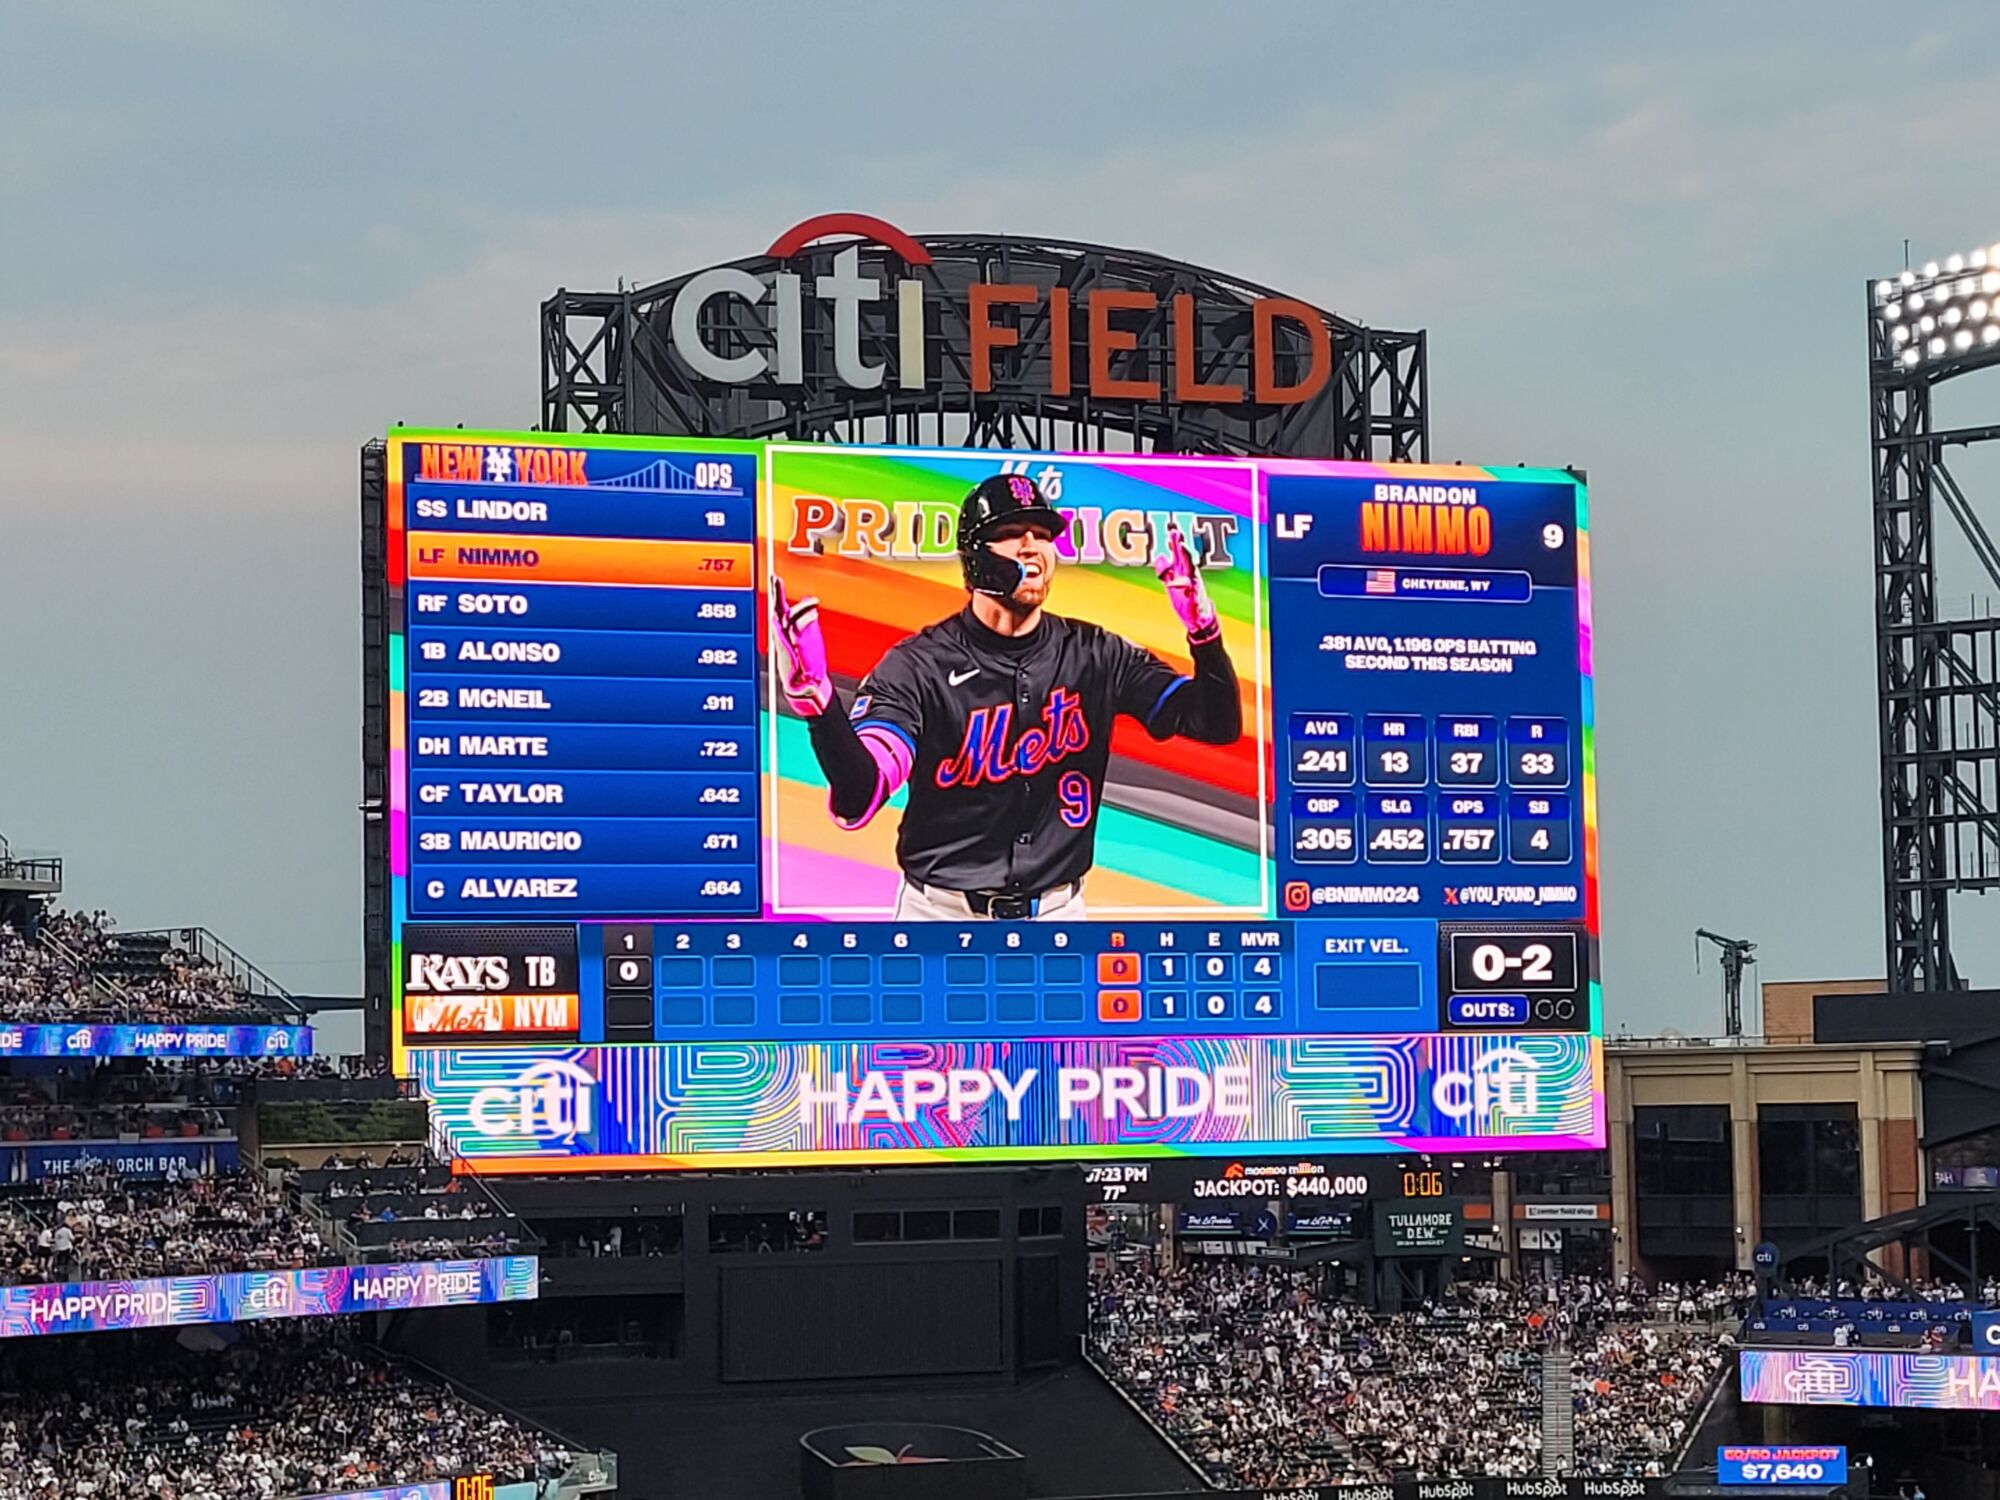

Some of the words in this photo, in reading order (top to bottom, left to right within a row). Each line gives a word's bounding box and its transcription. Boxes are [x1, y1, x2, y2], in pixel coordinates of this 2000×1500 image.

[672, 245, 924, 389] citi
[969, 284, 1331, 404] FIELD
[421, 445, 483, 482] NEW
[514, 448, 588, 486] YORK
[695, 463, 732, 489] OPS
[1374, 484, 1477, 505] BRANDON
[417, 499, 447, 517] SS
[457, 500, 547, 522] LINDOR
[705, 512, 725, 527] 1B
[788, 496, 962, 560] PRID
[1276, 513, 1313, 539] LF
[1361, 502, 1490, 556] NIMMO
[1543, 524, 1564, 549] 9
[418, 548, 445, 564] LF
[458, 548, 539, 567] NIMMO
[697, 558, 735, 572] .757
[1402, 578, 1469, 592] CHEYENNE,
[1470, 580, 1490, 591] WY
[418, 594, 448, 612] RF
[458, 594, 528, 614] SOTO
[697, 603, 737, 619] .858
[421, 642, 446, 660] 1B
[458, 641, 560, 662] ALONSO
[697, 650, 737, 665] .982
[1319, 636, 1350, 650] .381
[1354, 636, 1392, 654] AVG,
[1433, 639, 1466, 653] OPS
[1467, 639, 1537, 655] BATTING
[1345, 655, 1409, 670] SECOND
[1411, 656, 1448, 671] THIS
[1449, 656, 1513, 672] SEASON
[419, 690, 449, 708] 2B
[459, 689, 551, 709] MCNEIL
[702, 696, 734, 711] .911
[935, 685, 1091, 790] Mets
[1304, 721, 1338, 735] AVG
[1383, 722, 1405, 736] HR
[1454, 723, 1479, 737] RBI
[1531, 724, 1543, 738] R
[418, 737, 450, 755] DH
[460, 736, 548, 756] MARTE
[700, 742, 737, 757] .722
[1297, 751, 1347, 772] .241
[1381, 752, 1409, 773] 13
[1451, 753, 1482, 774] 37
[1521, 753, 1554, 774] 33
[420, 785, 449, 803] CF
[460, 784, 563, 804] TAYLOR
[699, 788, 740, 803] .642
[1059, 771, 1092, 827] 9
[1307, 799, 1339, 813] OBP
[1381, 800, 1412, 814] SLG
[1453, 800, 1484, 814] OPS
[1528, 800, 1549, 814] SB
[420, 832, 450, 851] 3B
[460, 831, 582, 851] MAURICIO
[702, 834, 737, 849] .671
[1296, 829, 1351, 850] .305
[1370, 829, 1424, 850] .452
[1443, 829, 1495, 850] .757
[1530, 830, 1549, 850] 4
[427, 880, 445, 898] C
[461, 878, 578, 898] ALVAREZ
[700, 881, 741, 896] .664
[1312, 887, 1420, 904] @BNIMMO24
[624, 935, 634, 948] 1
[676, 936, 691, 949] 2
[726, 935, 742, 948] 3
[794, 934, 808, 948] 4
[843, 934, 857, 948] 5
[894, 934, 908, 948] 6
[959, 934, 972, 948] 7
[1007, 934, 1020, 948] 8
[1054, 933, 1067, 947] 9
[1111, 933, 1124, 947] R
[1160, 933, 1173, 947] H
[1209, 933, 1221, 947] E
[1241, 932, 1279, 947] MVR
[1325, 939, 1364, 953] EXIT
[1370, 939, 1409, 953] VEL.
[405, 954, 509, 991] RAYS
[525, 956, 555, 987] TB
[619, 963, 638, 980] 0
[1162, 959, 1174, 976] 1
[1208, 959, 1222, 976] 0
[1254, 958, 1270, 975] 4
[1472, 945, 1552, 980] 0-2
[514, 997, 568, 1027] NYM
[1163, 998, 1175, 1014] 1
[1208, 998, 1223, 1014] 0
[1255, 997, 1271, 1013] 4
[1461, 1003, 1515, 1018] OUTS:
[67, 1032, 91, 1048] citi
[135, 1034, 182, 1048] HAPPY
[185, 1034, 226, 1048] PRIDE
[266, 1033, 288, 1048] citi
[800, 1067, 1038, 1124] HAPPY
[1058, 1066, 1254, 1121] PRIDE
[1433, 1056, 1538, 1118] citi
[469, 1066, 592, 1135] citi
[43, 1160, 71, 1174] THE
[107, 1158, 153, 1173] ORCH
[159, 1157, 186, 1171] BAR
[1125, 1168, 1147, 1181] PM
[1245, 1166, 1286, 1175] moomoo
[1289, 1163, 1324, 1175] million
[1103, 1185, 1127, 1200] 77°
[1194, 1179, 1279, 1197] JACKPOT:
[1287, 1177, 1367, 1197] $440,000
[1404, 1172, 1442, 1196] 0:06
[1388, 1214, 1452, 1227] TULLAMORE
[250, 1279, 286, 1308] citi
[354, 1275, 422, 1300] HAPPY
[425, 1271, 480, 1295] PRIDE
[31, 1294, 112, 1322] HAPPY
[115, 1289, 180, 1317] PRIDE
[1949, 1368, 2000, 1398] HA
[1742, 1463, 1823, 1483] $7,640
[1338, 1487, 1394, 1500] HubSpot
[1419, 1484, 1474, 1500] HubSpot
[1507, 1479, 1568, 1498] HubSpot
[1584, 1480, 1645, 1497] HubSpot
